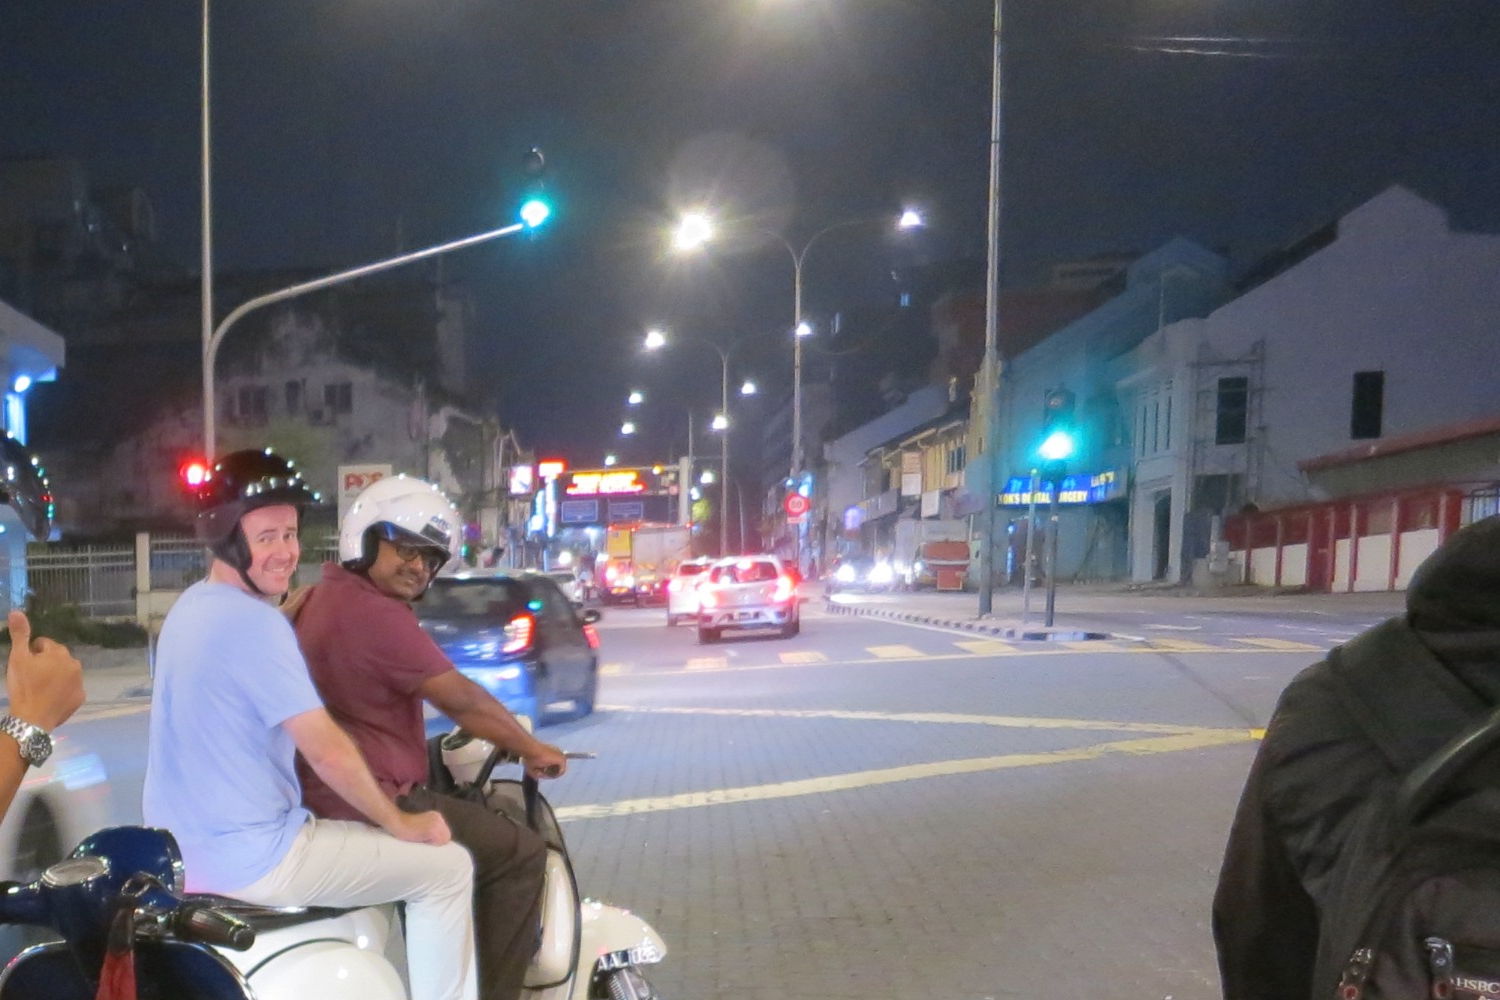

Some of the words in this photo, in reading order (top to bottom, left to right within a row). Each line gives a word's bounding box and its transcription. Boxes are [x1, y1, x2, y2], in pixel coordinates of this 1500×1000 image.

[1021, 491, 1051, 504] DETAL
[1058, 490, 1088, 503] URGERY
[1456, 977, 1500, 994] HSBC
